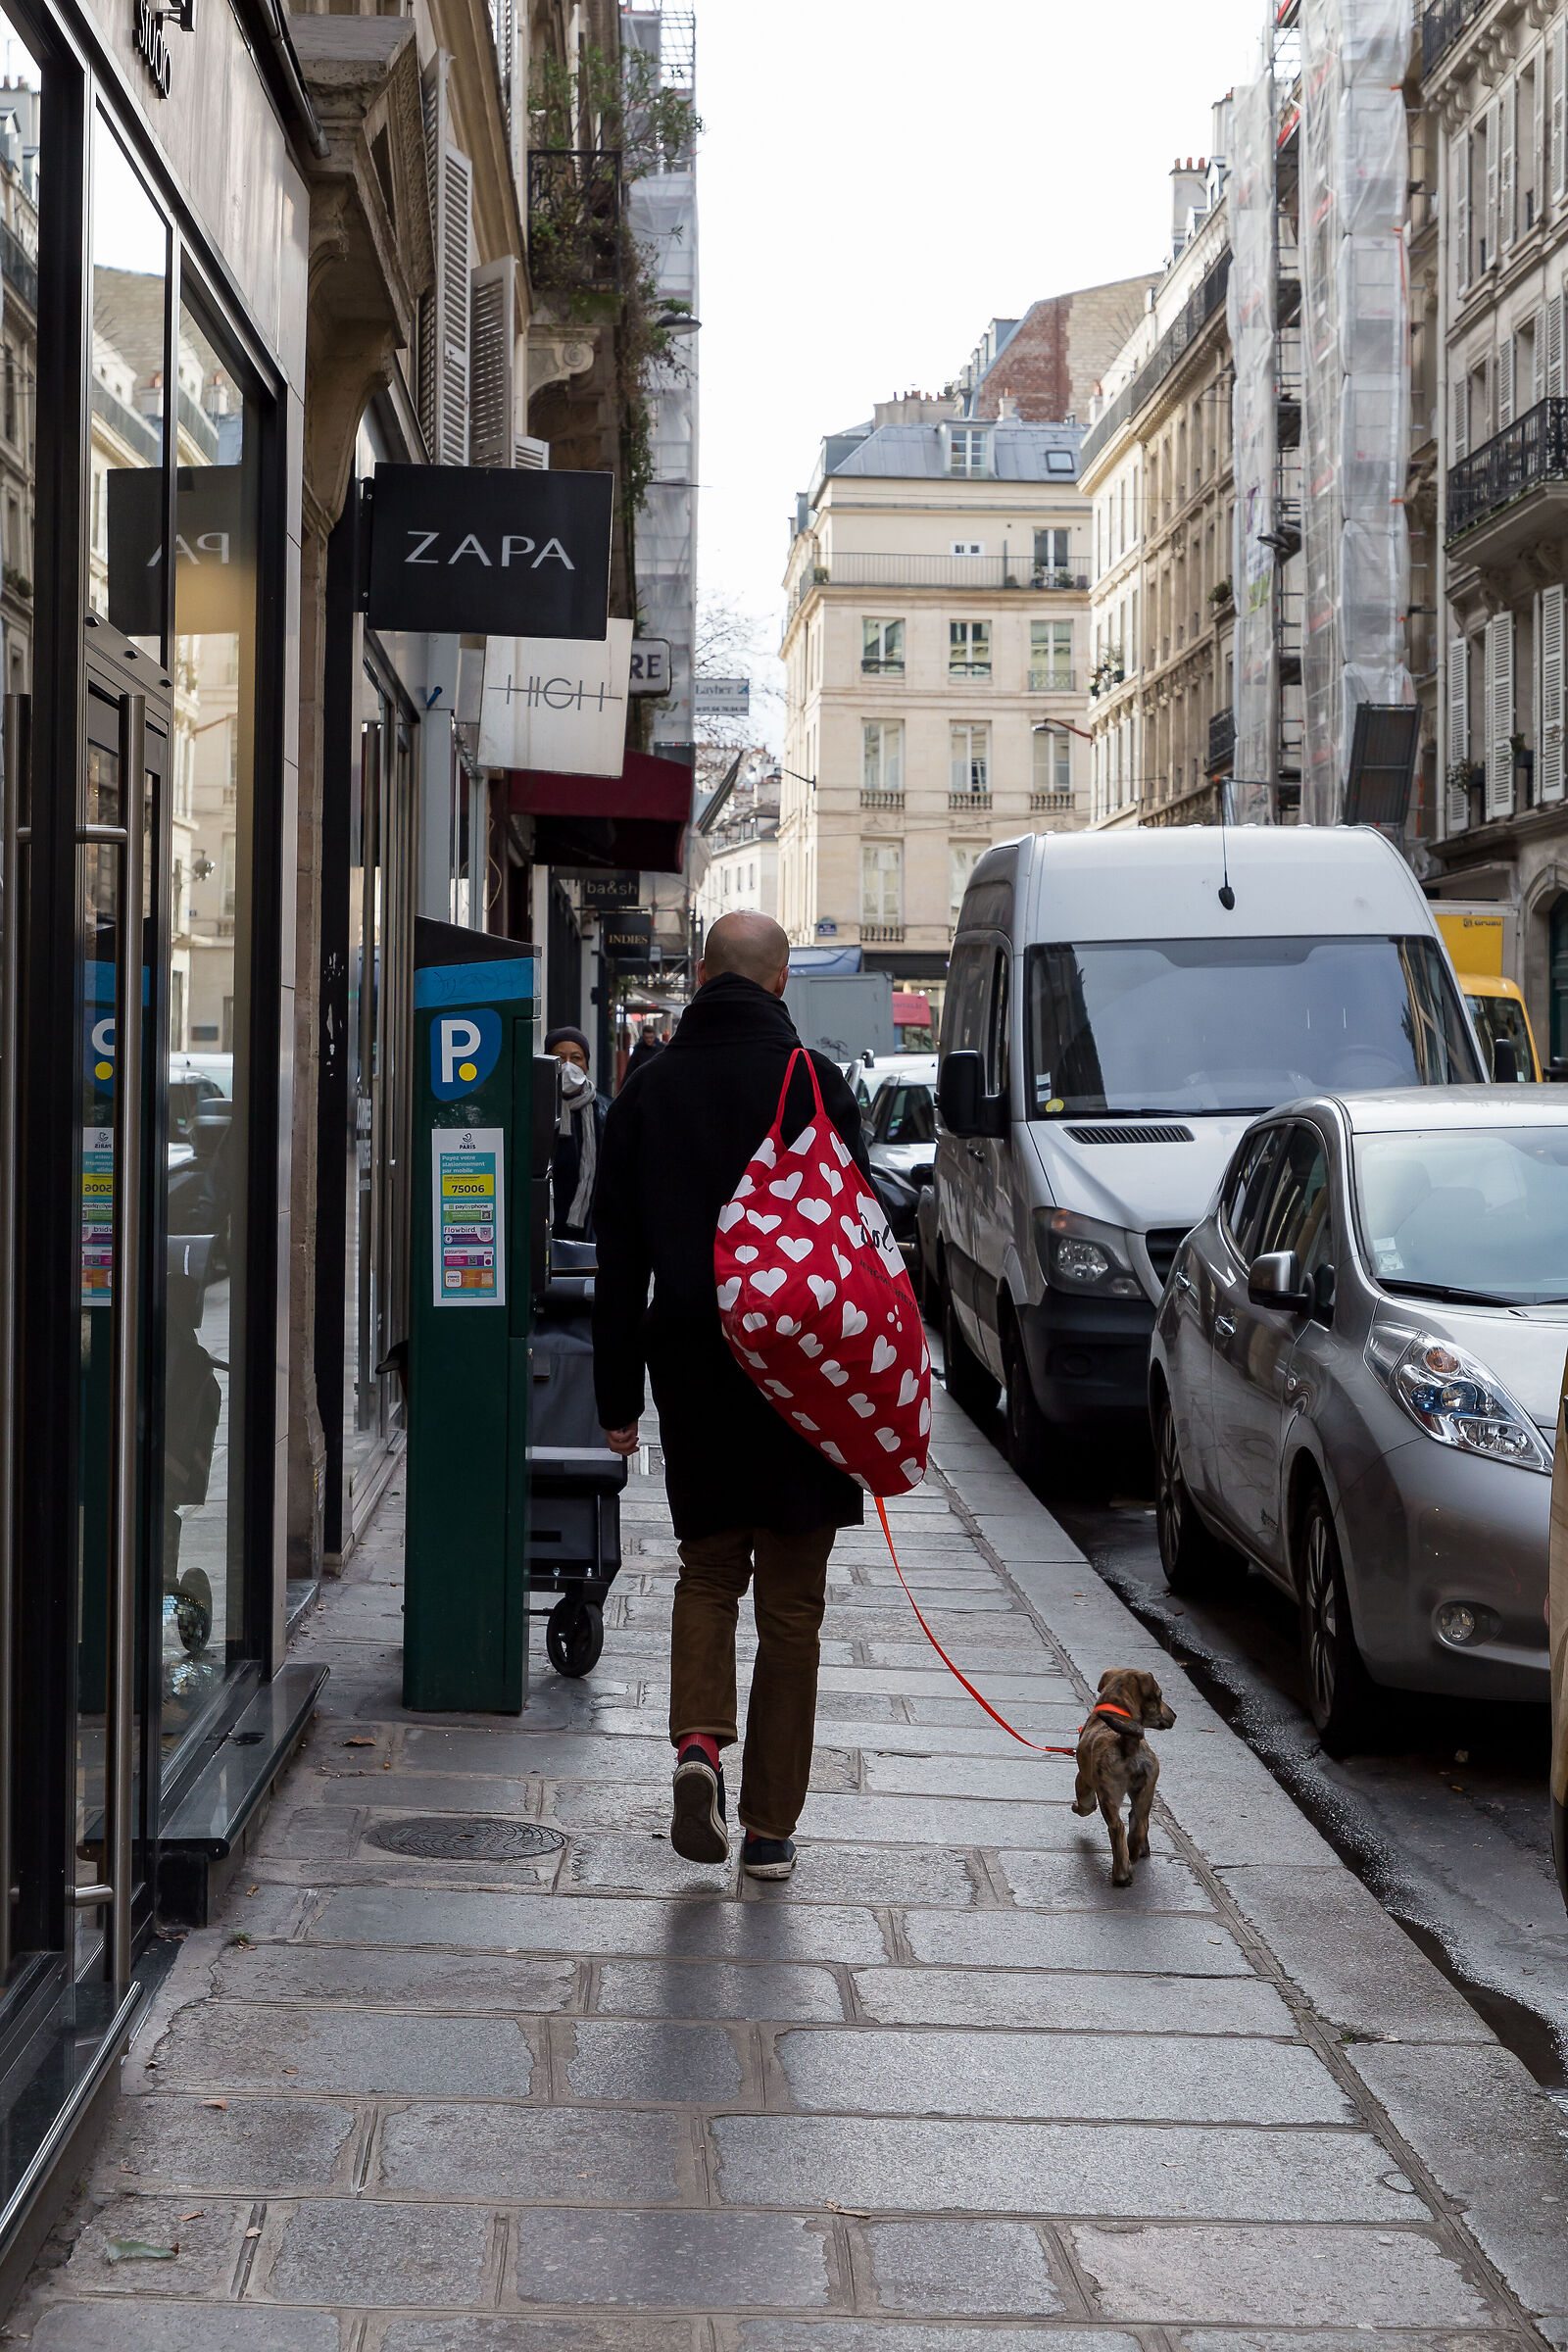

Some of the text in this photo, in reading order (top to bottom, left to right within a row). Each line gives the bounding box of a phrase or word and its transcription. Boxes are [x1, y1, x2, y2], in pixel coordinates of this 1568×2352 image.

[404, 530, 575, 570] ZAPA
[487, 673, 623, 712] HIGH
[587, 880, 637, 895] ba&sh
[609, 934, 649, 945] INDIES
[452, 1184, 485, 1194] 75006
